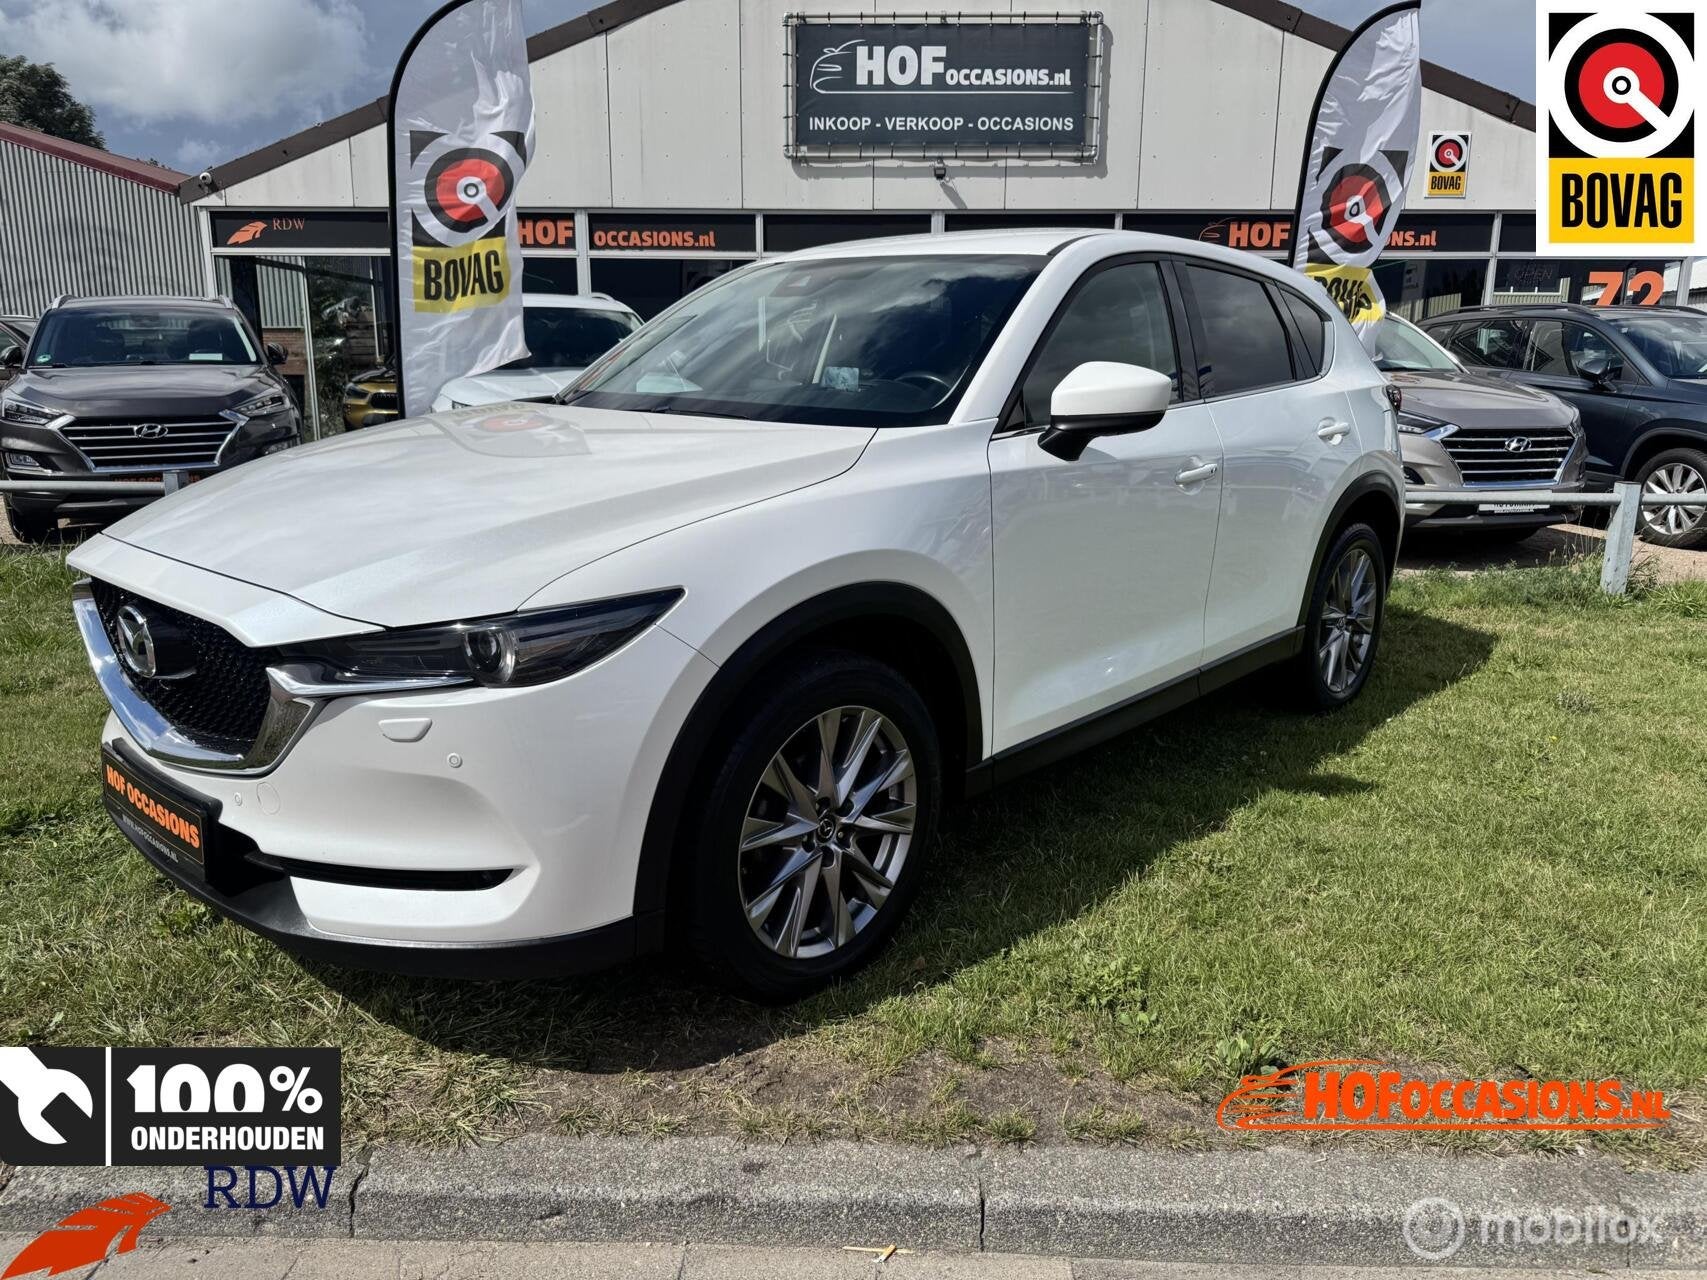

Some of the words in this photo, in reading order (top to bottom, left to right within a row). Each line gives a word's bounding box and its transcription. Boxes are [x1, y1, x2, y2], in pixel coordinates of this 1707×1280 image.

[809, 116, 871, 131] INKOOP
[885, 116, 964, 131] VERKOOP
[977, 116, 1074, 131] OCCASIONS
[1430, 175, 1462, 190] BOVAG
[272, 217, 305, 231] RDW
[518, 219, 574, 245] HOF
[593, 230, 716, 247] OCCASIONS.nl
[1228, 221, 1291, 247] HOF
[424, 250, 504, 302] BOVAG
[1588, 270, 1665, 305] 72
[106, 764, 126, 796] HOF
[126, 782, 200, 849] OCCASIONS
